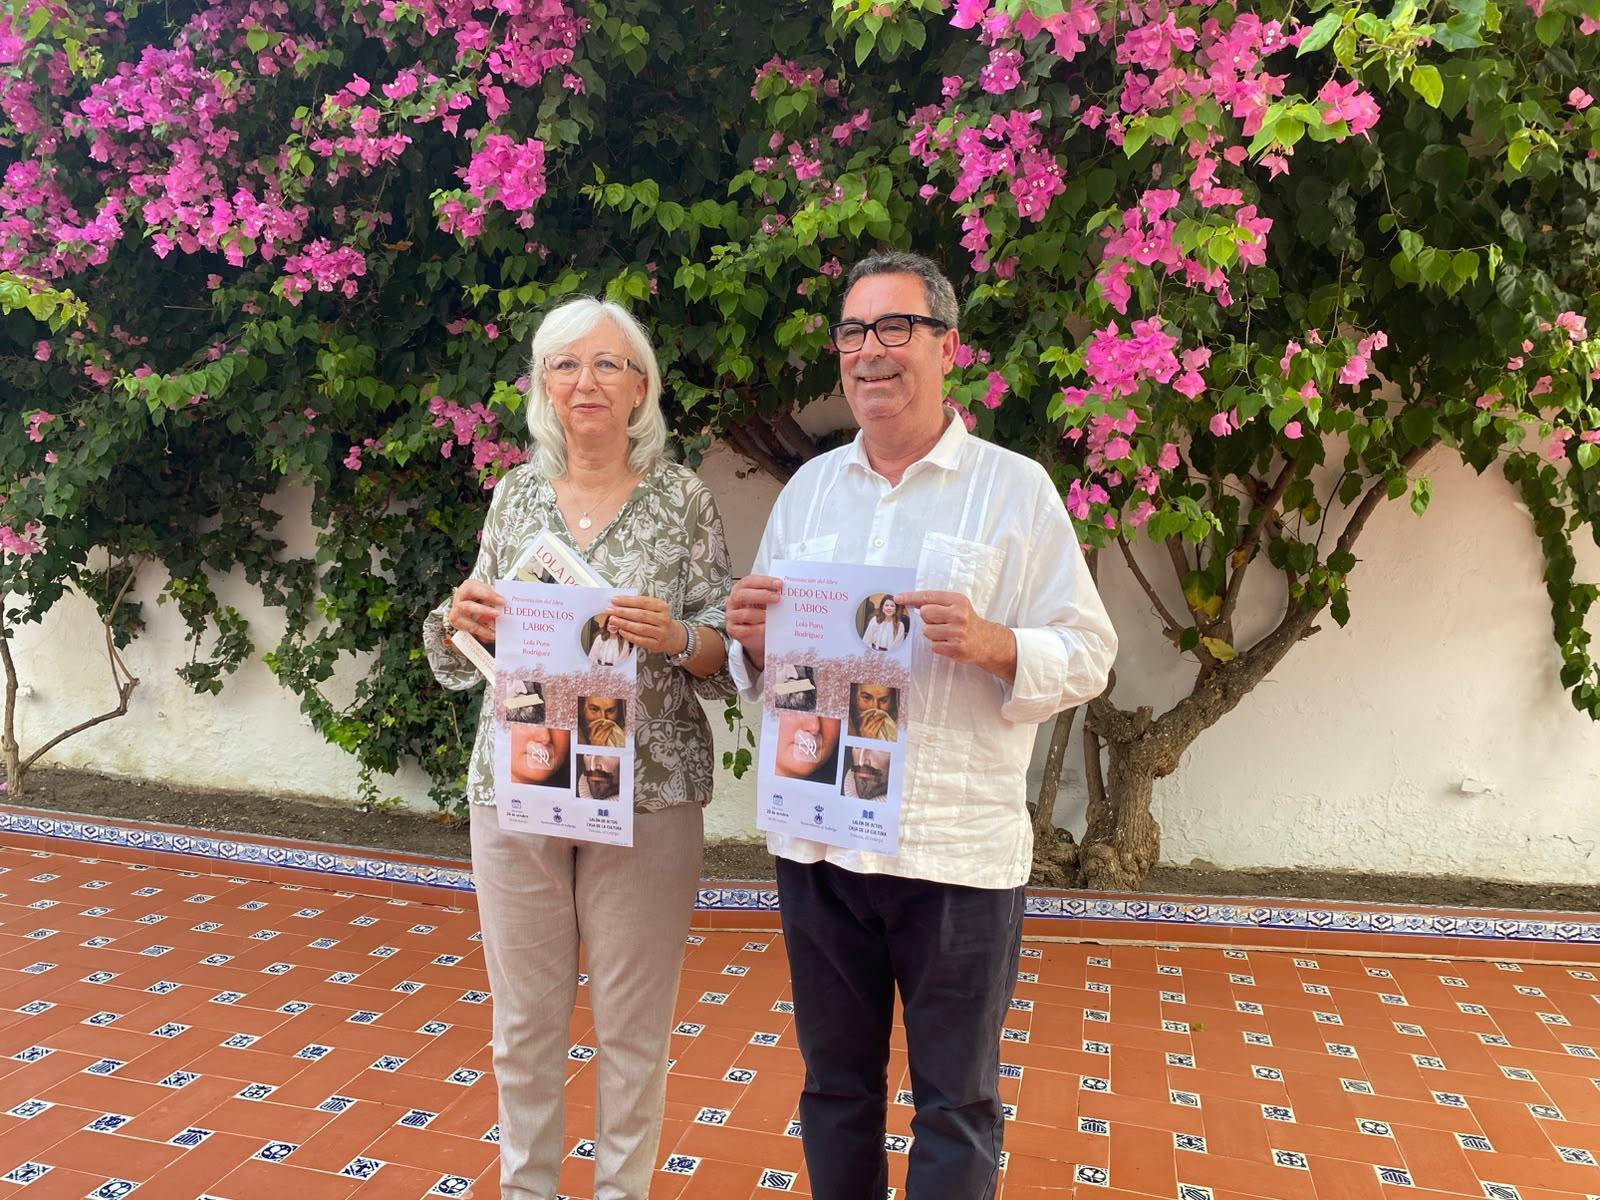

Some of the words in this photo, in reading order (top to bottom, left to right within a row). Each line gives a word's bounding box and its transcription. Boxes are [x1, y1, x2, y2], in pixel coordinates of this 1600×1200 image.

[536, 545, 564, 578] LOLA
[788, 588, 813, 598] DEDO
[815, 590, 828, 600] EN
[830, 591, 848, 600] LOS
[504, 607, 514, 616] EL
[516, 608, 541, 617] DEDO
[542, 610, 554, 619] EN
[556, 611, 574, 620] LOS
[794, 603, 828, 614] LABIOS
[522, 622, 555, 632] LABIOS
